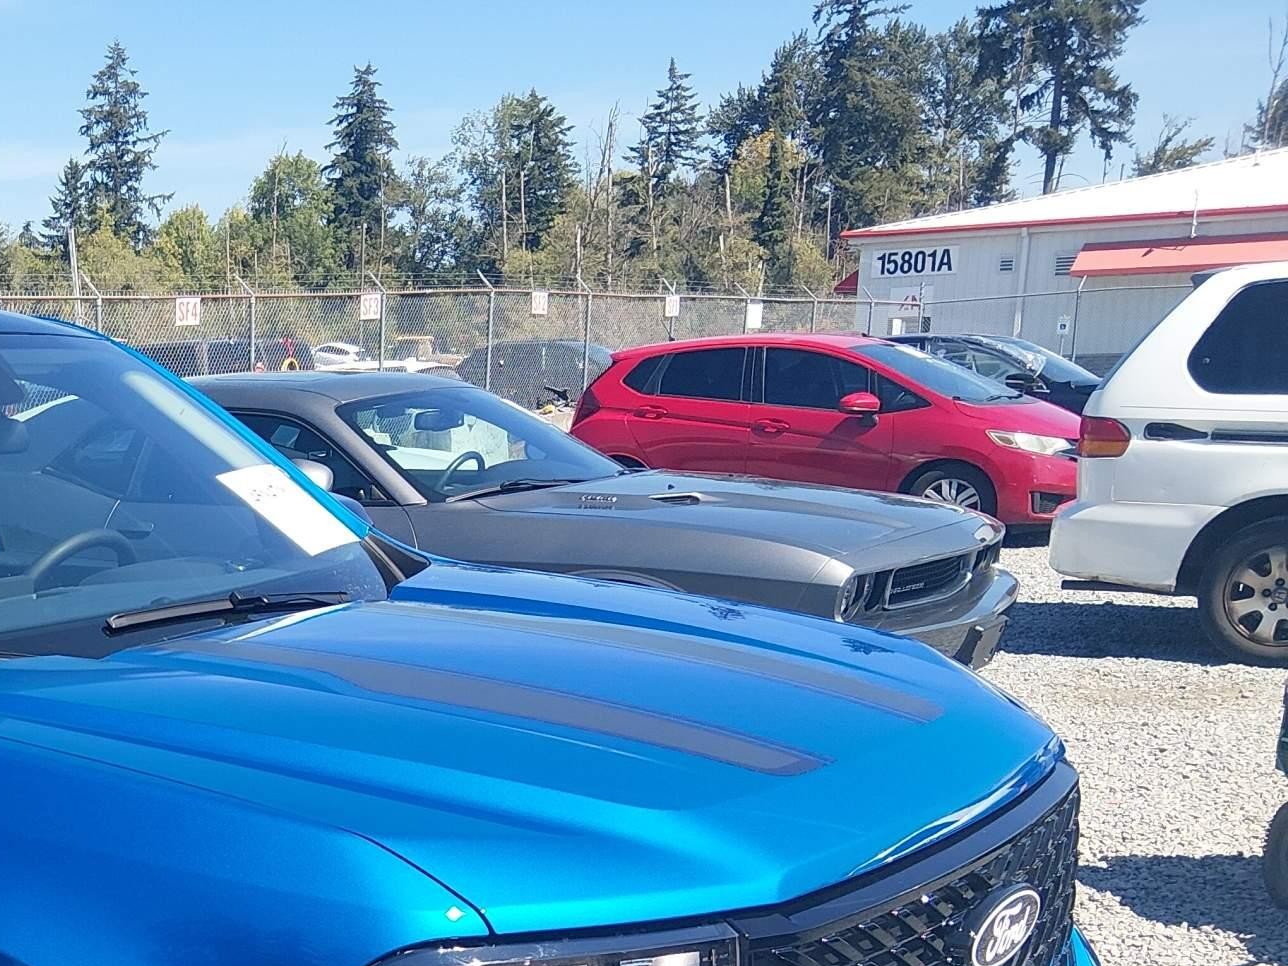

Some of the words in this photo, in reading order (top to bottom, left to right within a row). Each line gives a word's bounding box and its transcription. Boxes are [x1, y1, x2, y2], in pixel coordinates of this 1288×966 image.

[876, 248, 953, 276] 15801A
[178, 301, 198, 322] SF4
[363, 297, 379, 316] SF3
